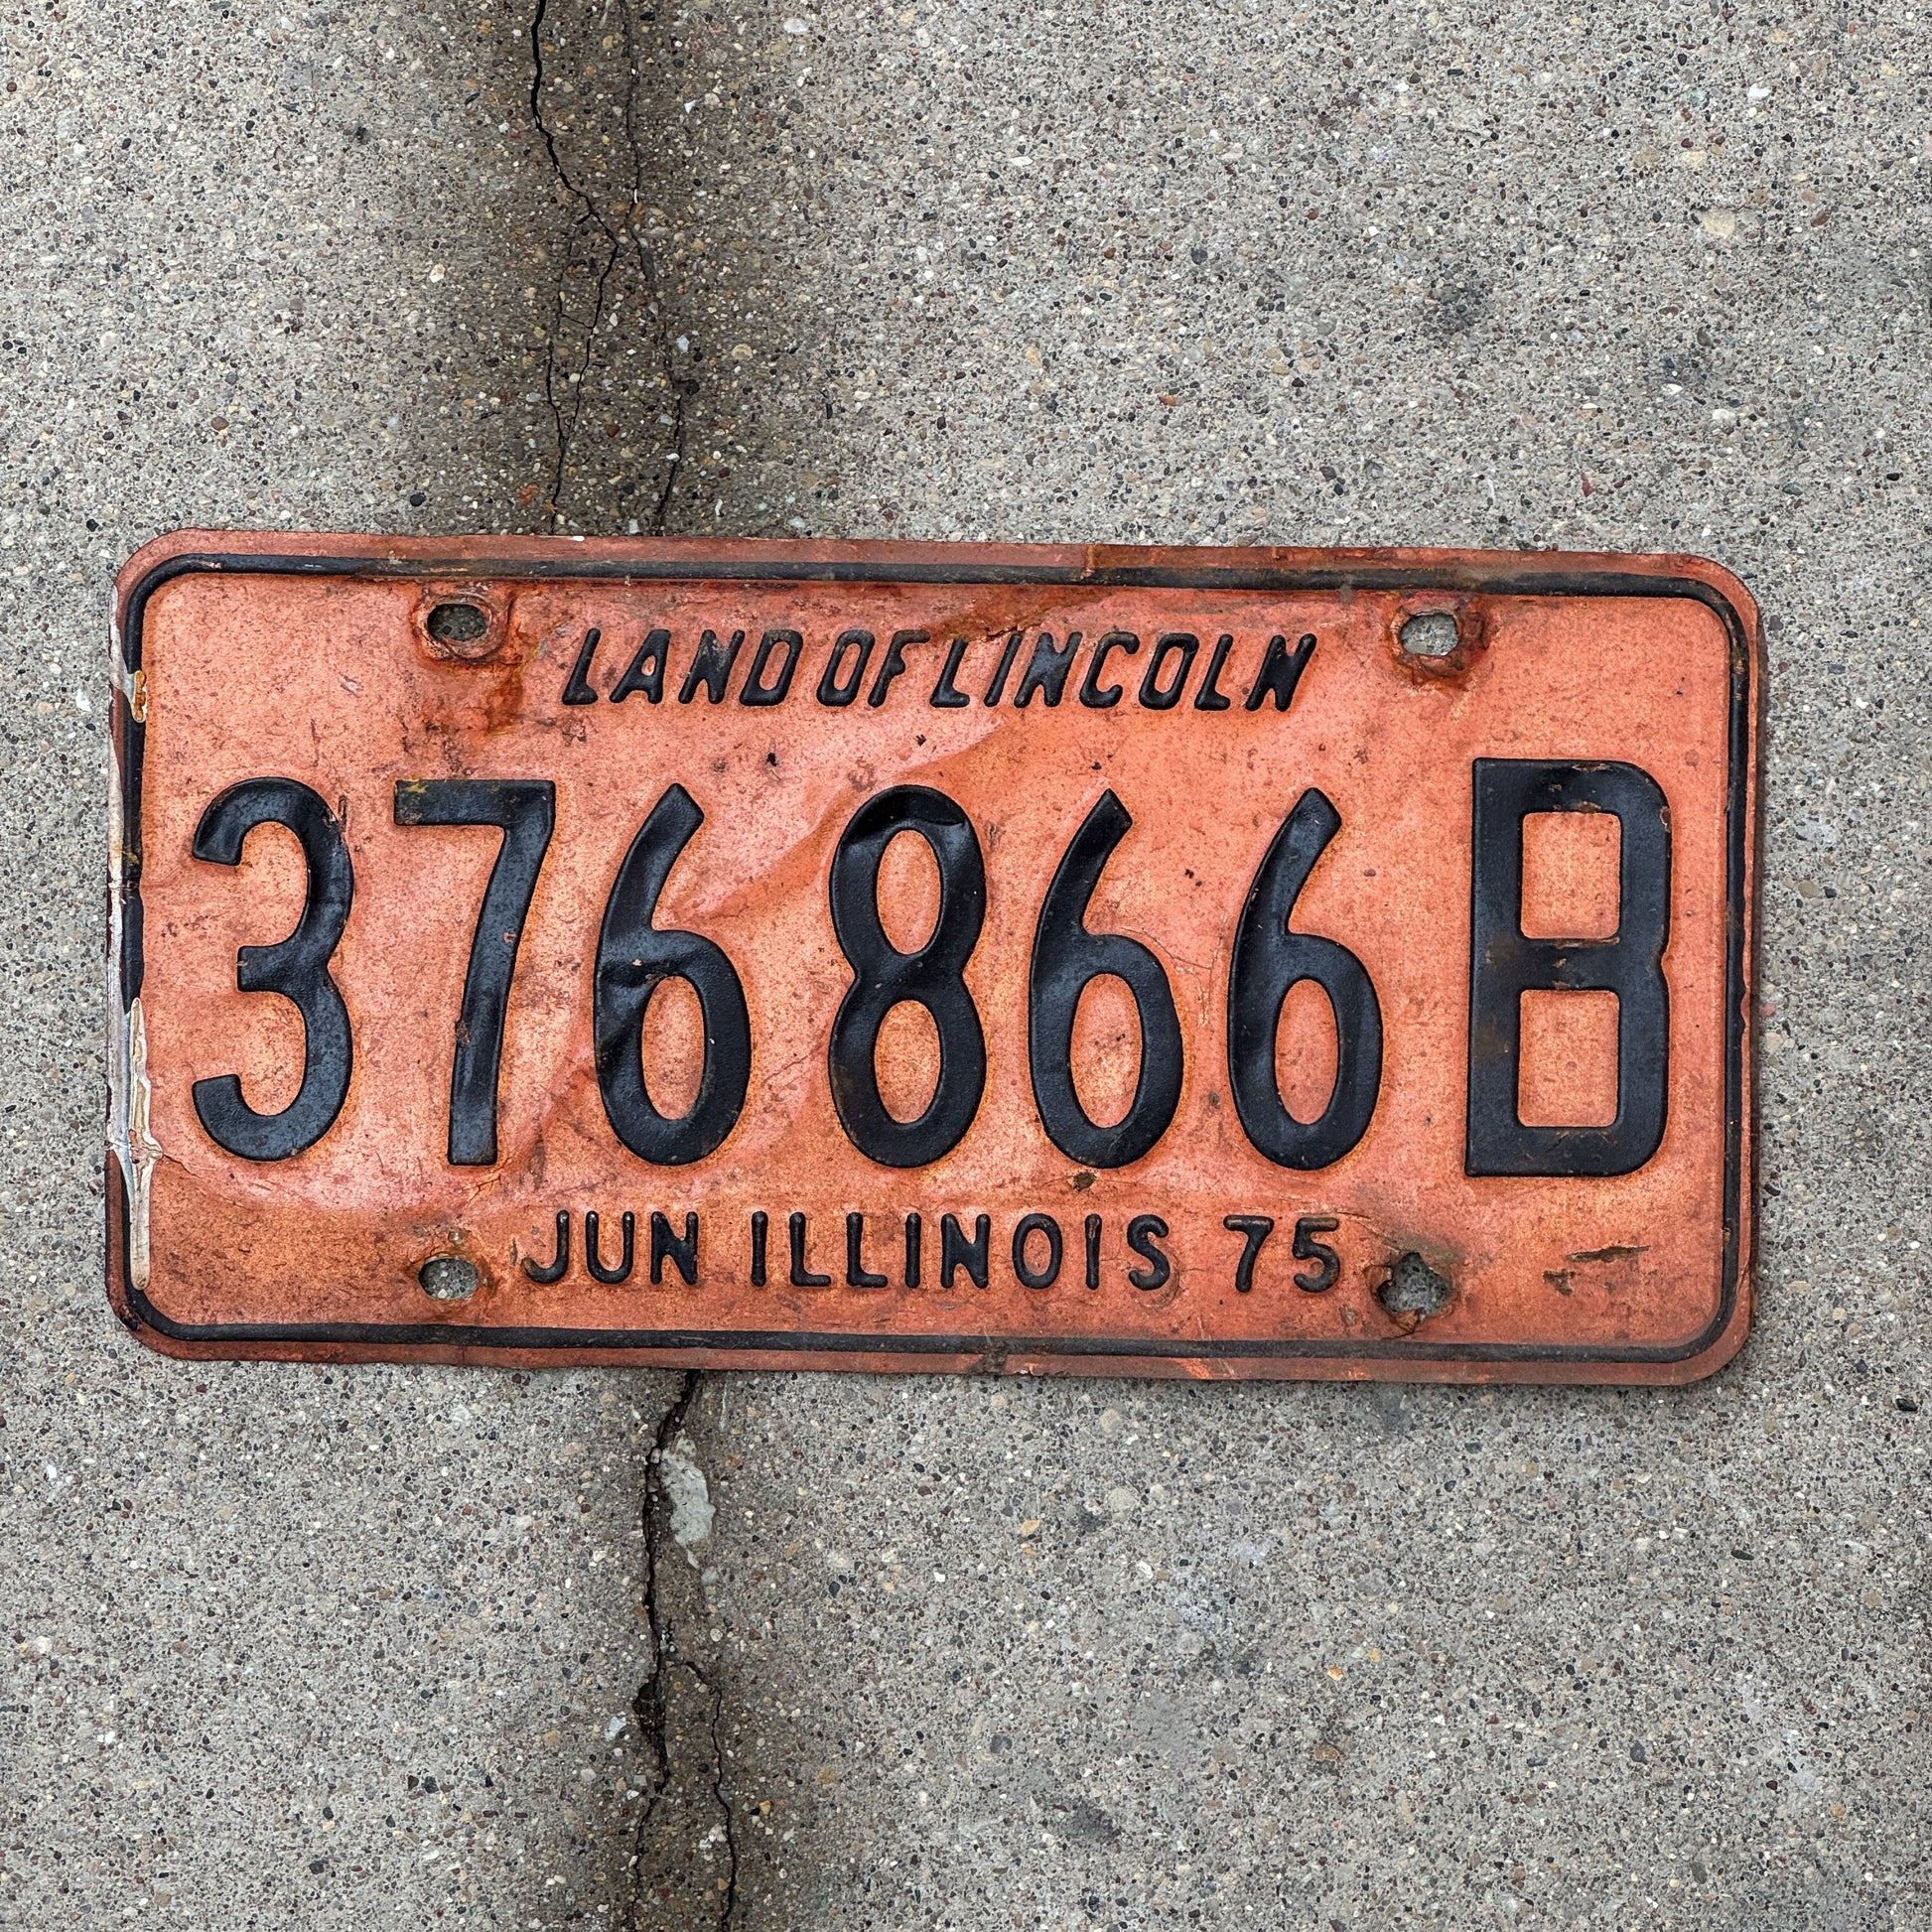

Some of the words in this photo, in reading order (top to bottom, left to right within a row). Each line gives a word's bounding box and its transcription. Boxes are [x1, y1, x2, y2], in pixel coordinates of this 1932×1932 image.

[561, 627, 804, 707] LAND
[815, 628, 931, 708] OF
[929, 627, 1317, 712] LINCOLN
[521, 1210, 700, 1287] JUN
[750, 1211, 1171, 1292] ILLINOIS
[1222, 1215, 1341, 1294] 75
